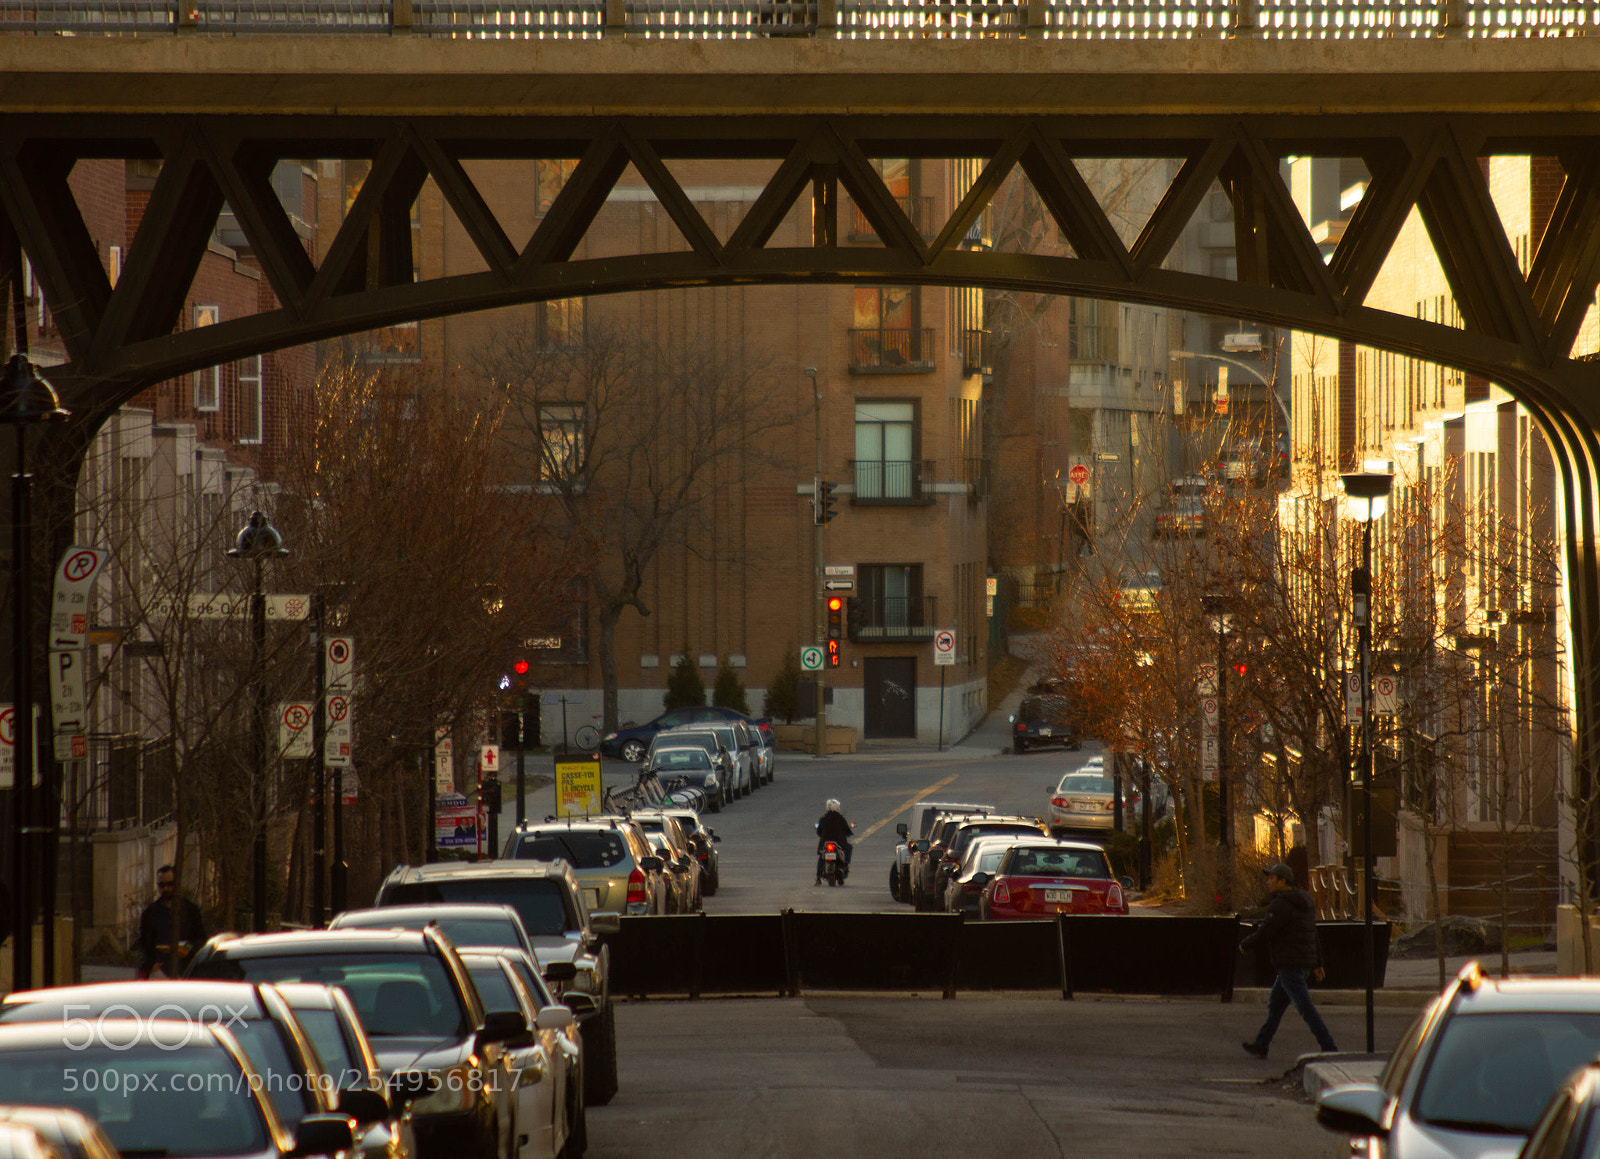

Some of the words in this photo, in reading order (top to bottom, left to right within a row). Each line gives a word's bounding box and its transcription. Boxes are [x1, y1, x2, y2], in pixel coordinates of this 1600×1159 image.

[153, 601, 275, 616] Pot-de-Quc
[60, 653, 72, 682] P
[62, 685, 72, 698] 2h
